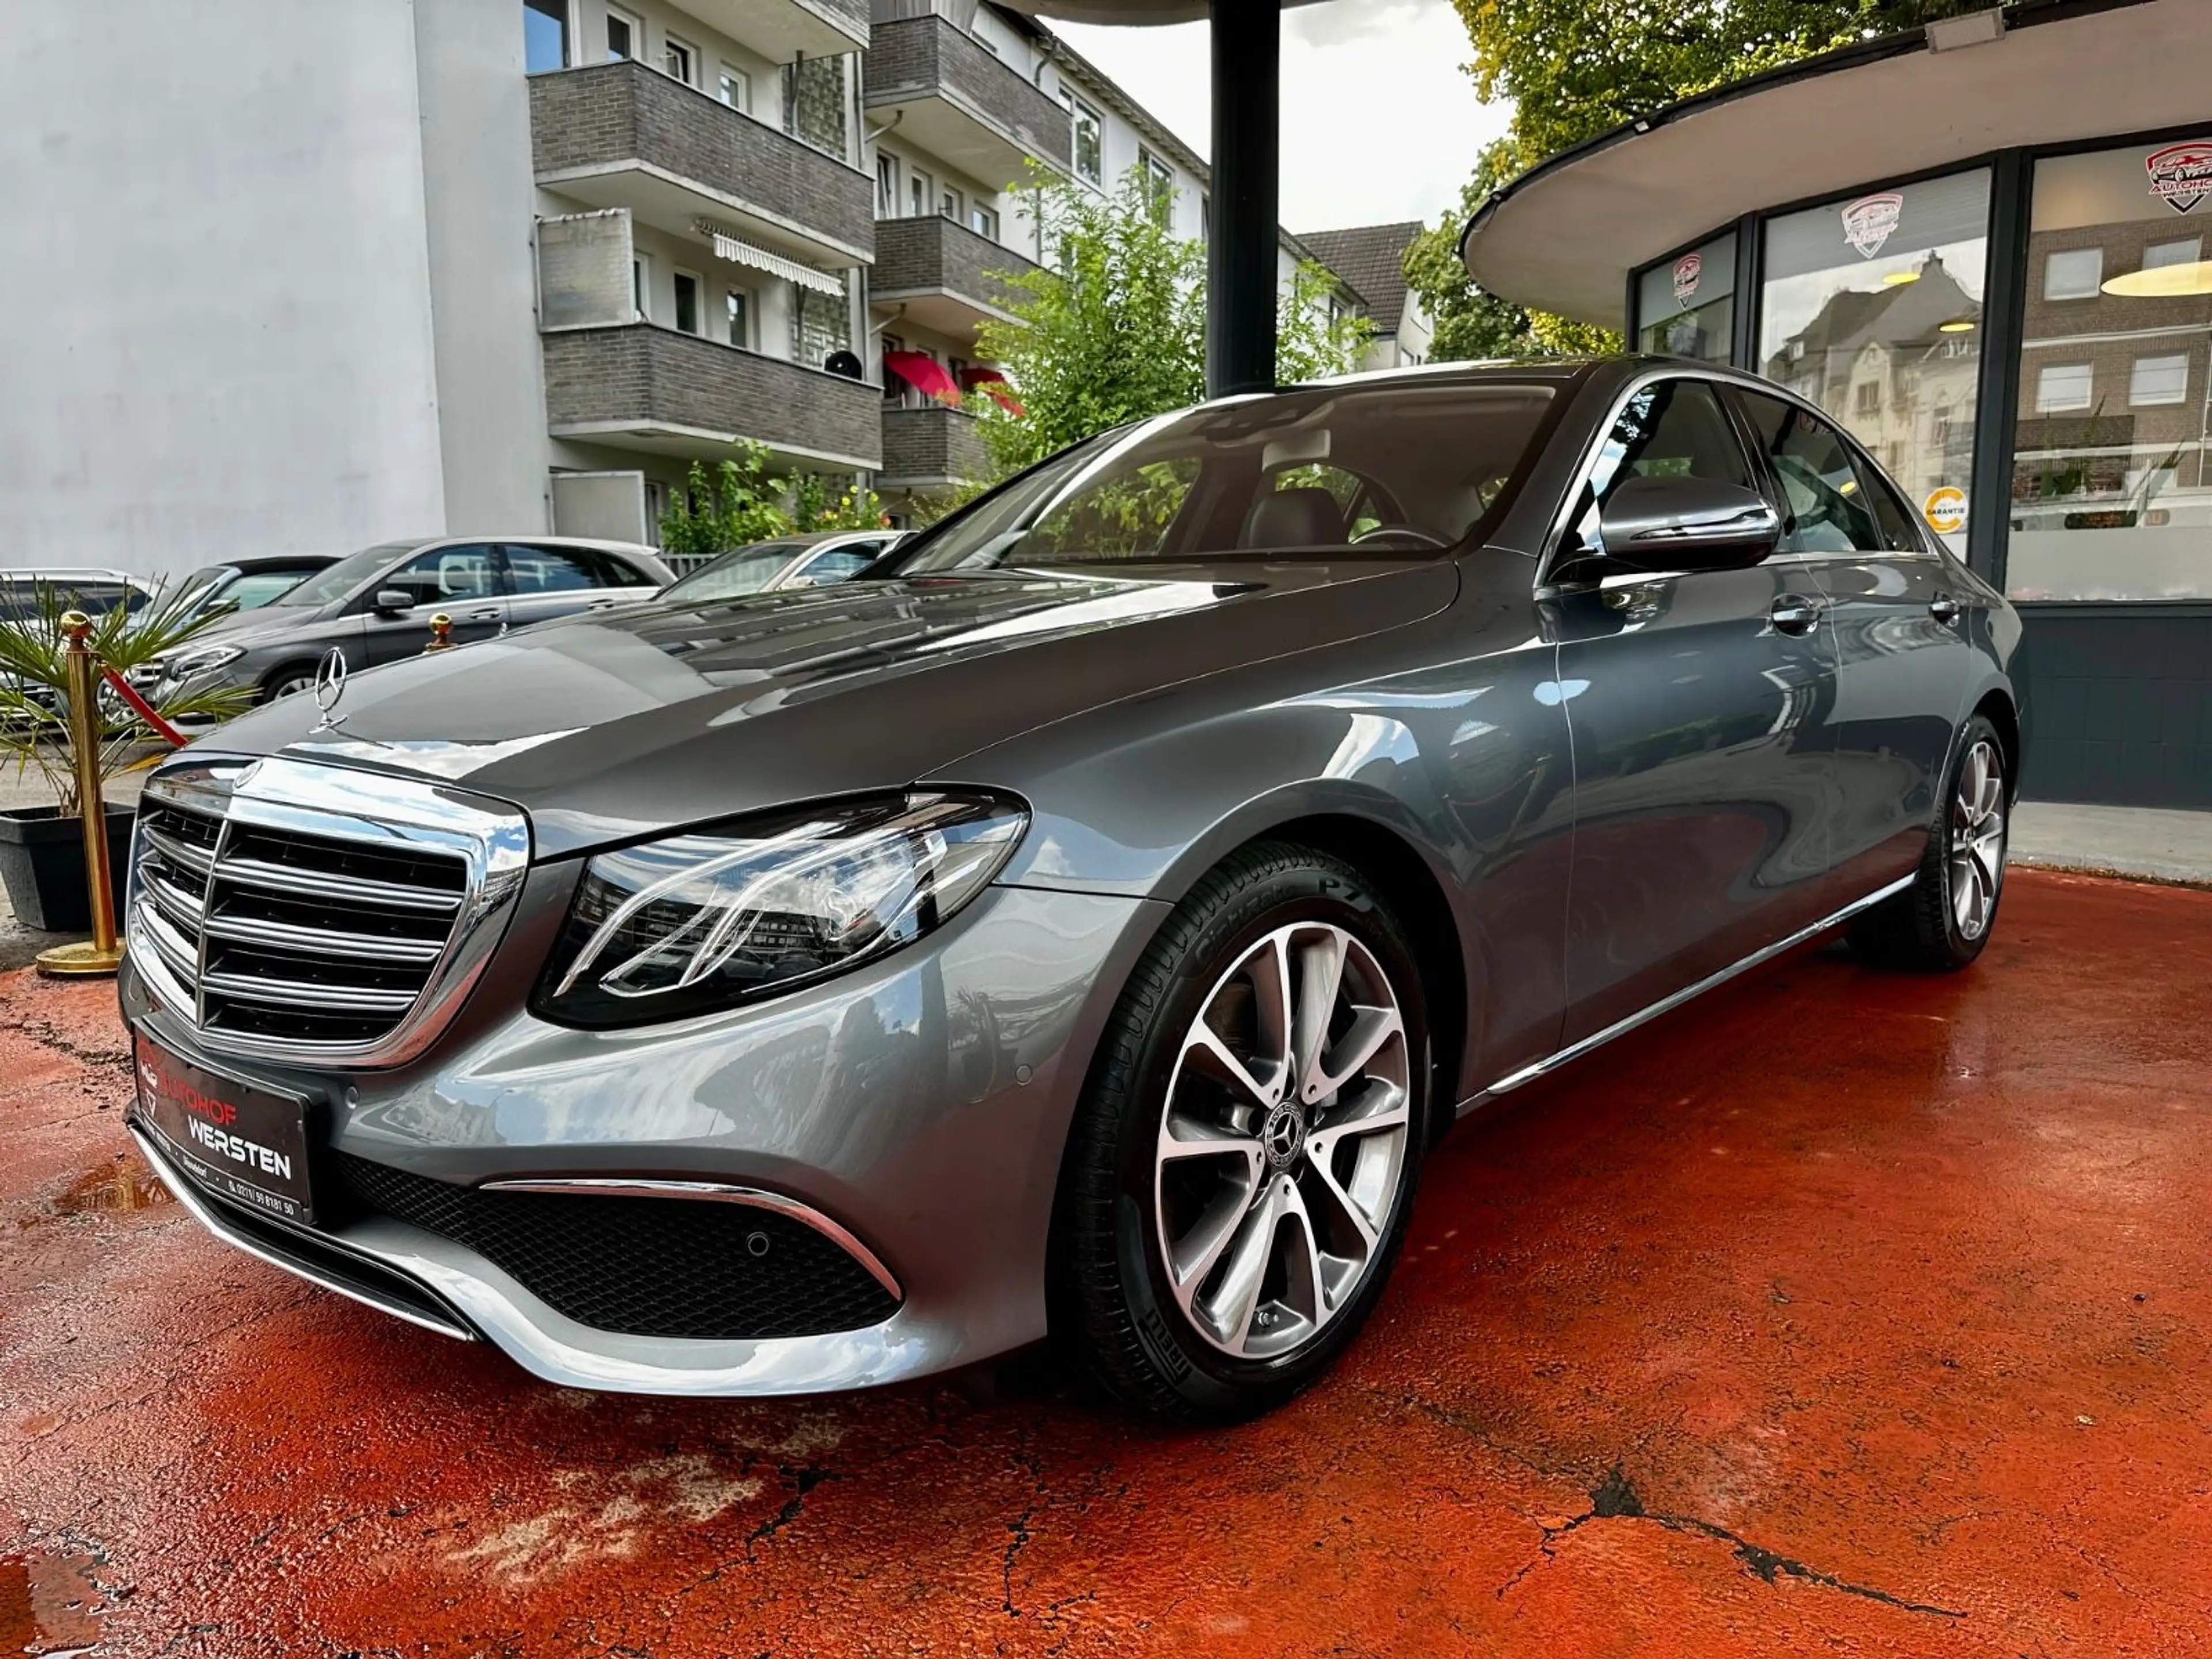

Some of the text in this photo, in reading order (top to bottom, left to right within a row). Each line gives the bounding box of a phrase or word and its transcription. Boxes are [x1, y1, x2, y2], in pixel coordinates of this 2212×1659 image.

[1319, 878, 1361, 901] P7
[159, 1071, 237, 1126] AUTOHOF
[188, 1114, 291, 1180] WERSTEN
[1137, 1308, 1193, 1385] PIRELLI
